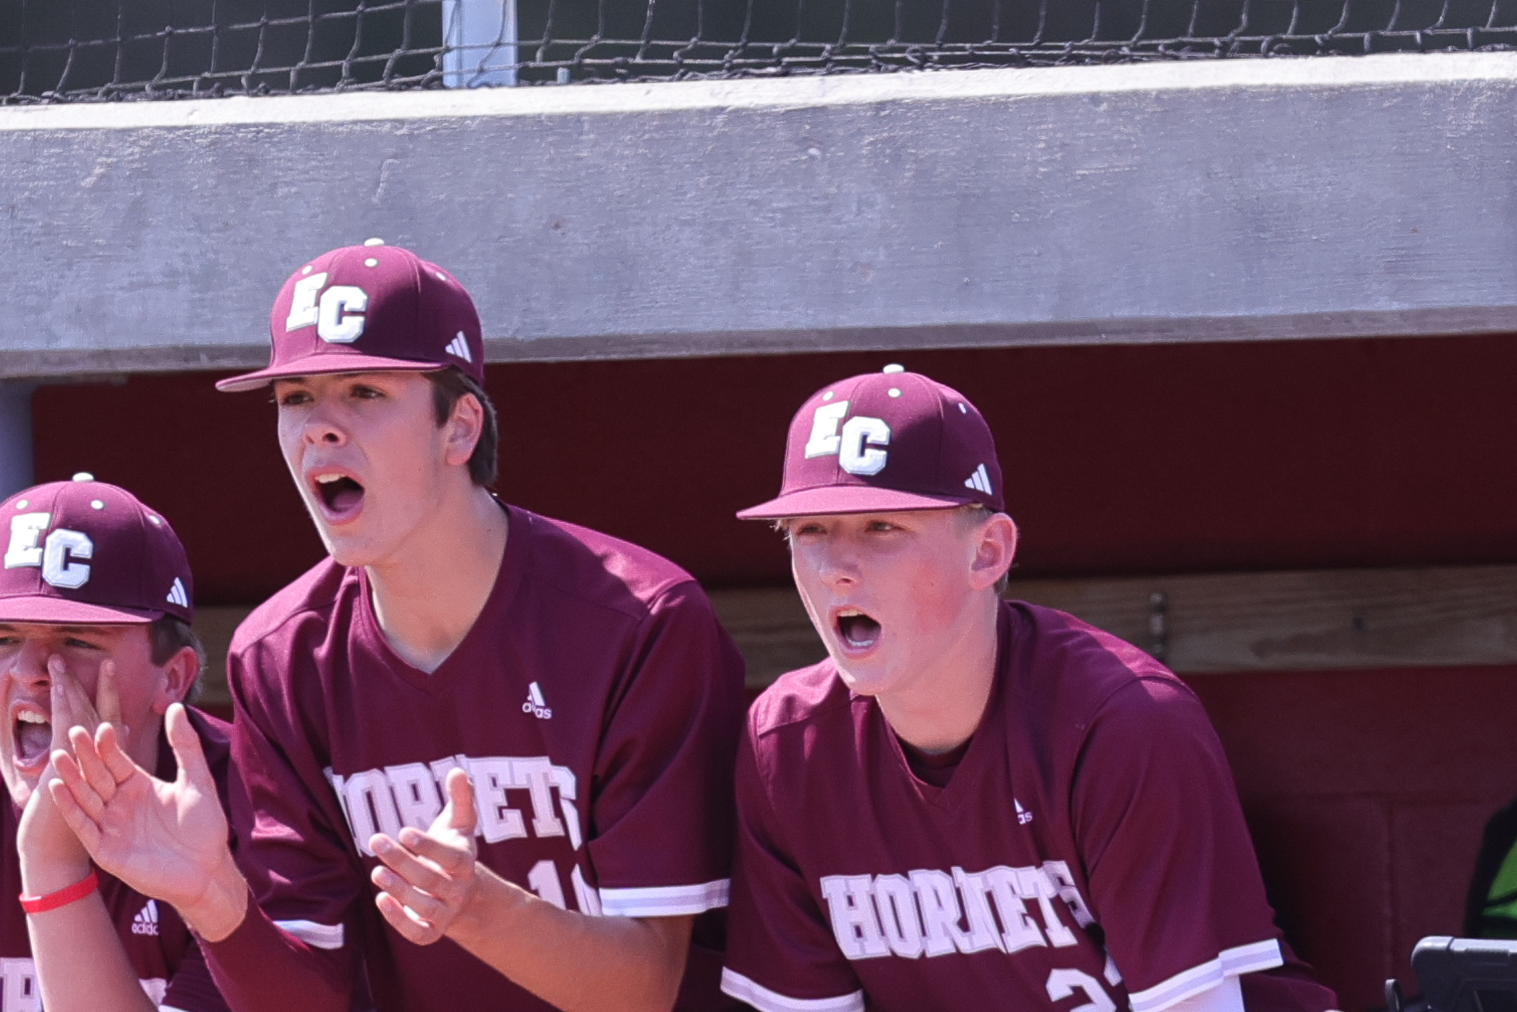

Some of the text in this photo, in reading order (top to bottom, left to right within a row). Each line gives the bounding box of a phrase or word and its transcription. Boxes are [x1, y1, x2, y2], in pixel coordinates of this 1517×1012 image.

[286, 272, 368, 343] EC
[805, 400, 891, 476] EC
[4, 512, 94, 589] EC
[522, 702, 552, 719] aas
[323, 754, 583, 858] ORET
